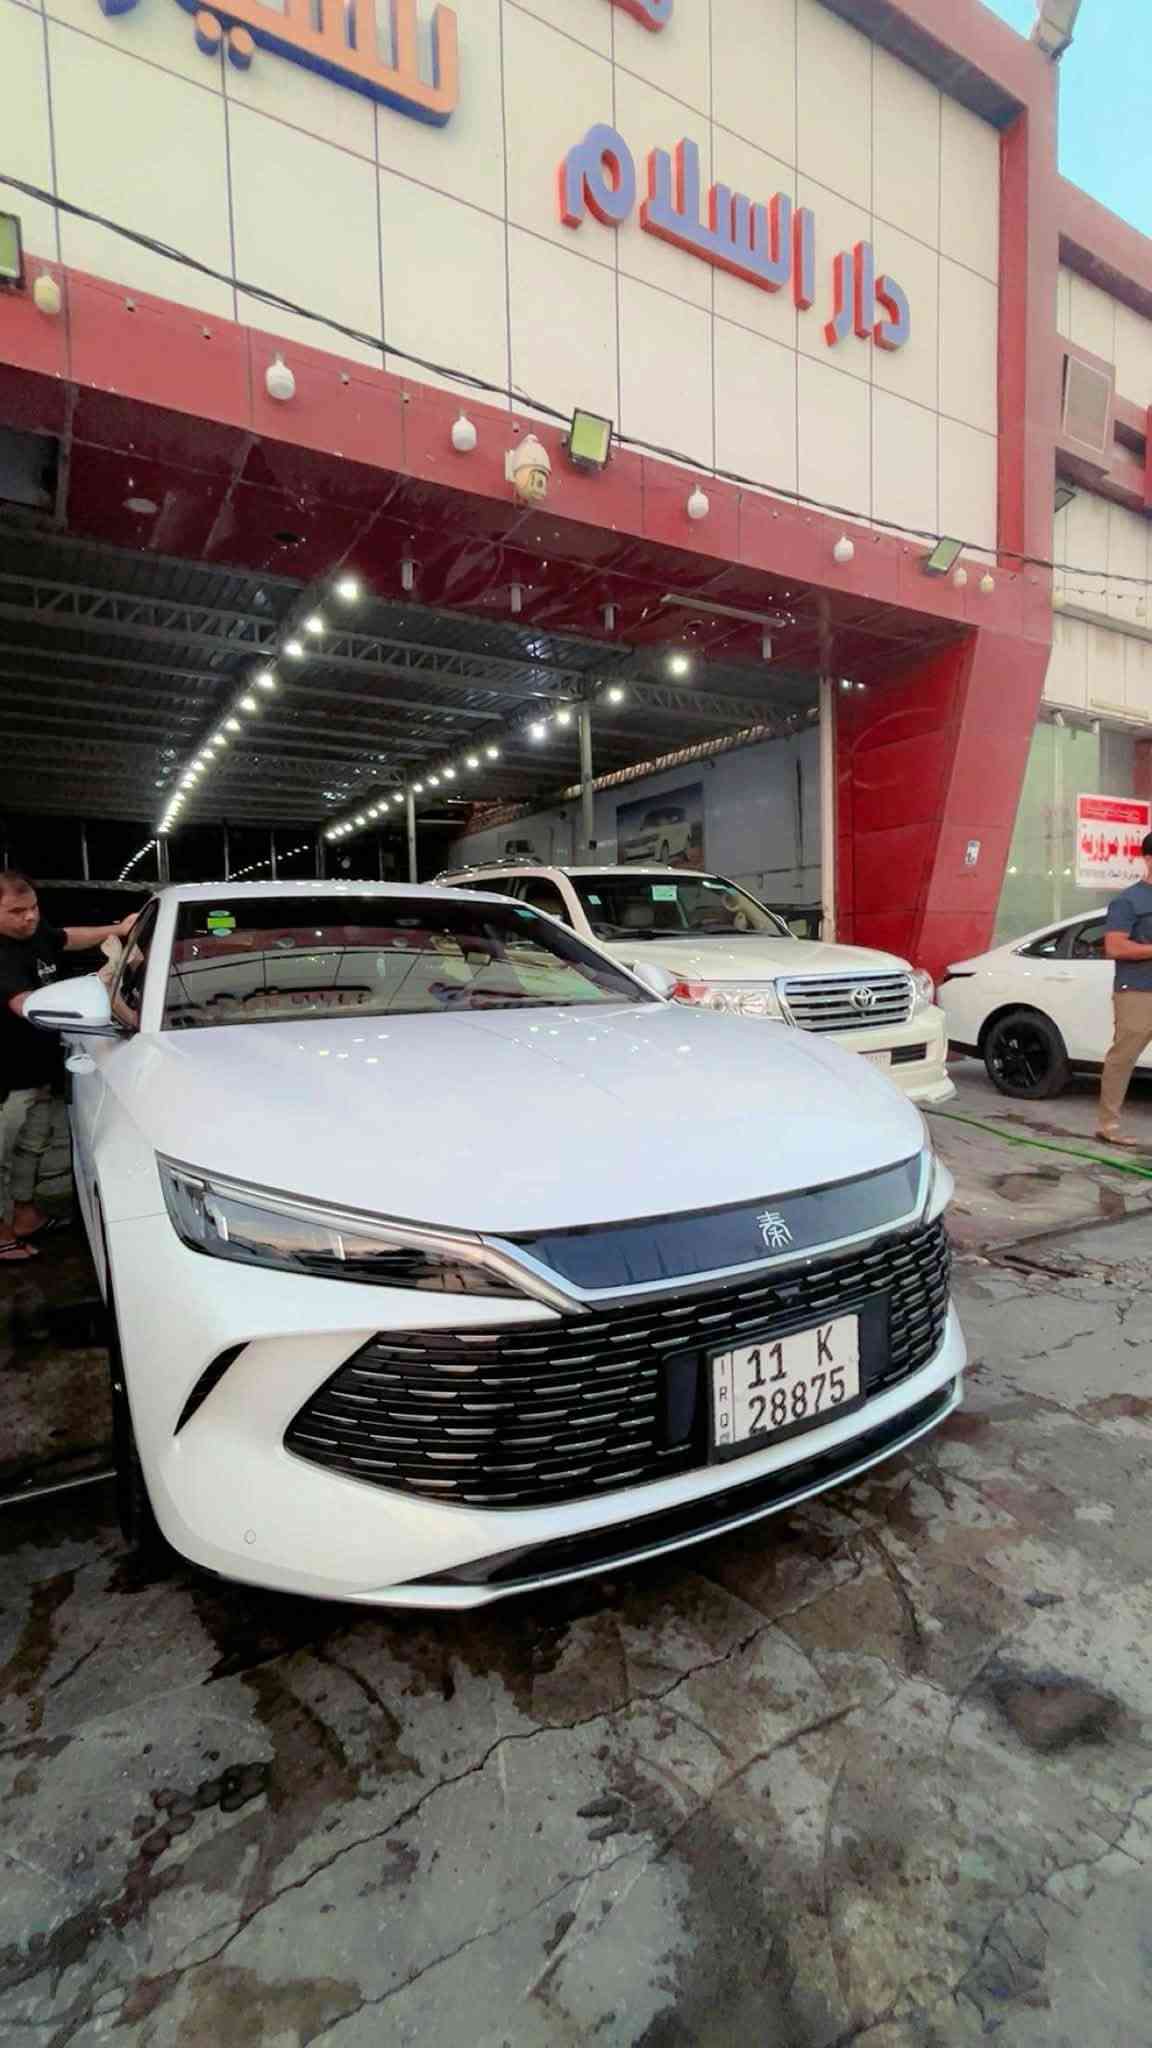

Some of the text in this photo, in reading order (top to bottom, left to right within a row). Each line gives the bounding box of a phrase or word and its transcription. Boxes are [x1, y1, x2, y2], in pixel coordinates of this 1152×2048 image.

[556, 123, 910, 350] دار السلام
[747, 1325, 833, 1389] 11 K
[748, 1366, 845, 1435] 28875
